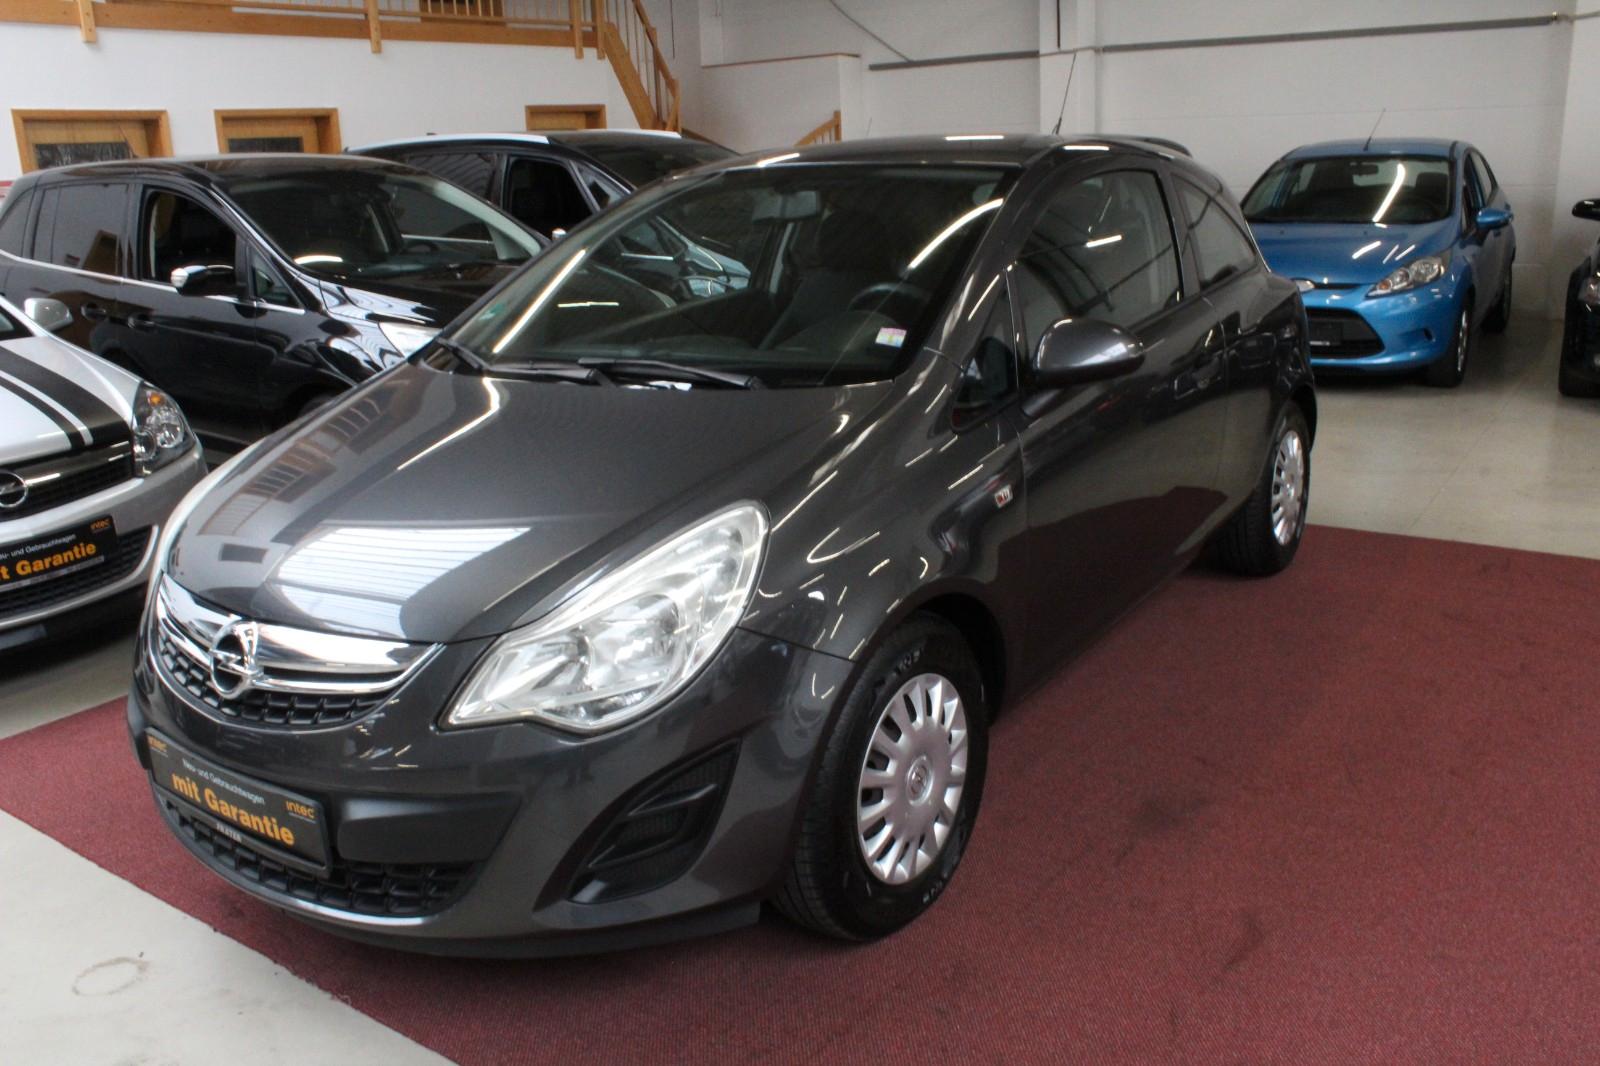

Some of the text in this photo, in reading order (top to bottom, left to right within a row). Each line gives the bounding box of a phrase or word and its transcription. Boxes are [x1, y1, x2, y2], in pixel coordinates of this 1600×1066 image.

[0, 542, 97, 581] t Garantie
[11, 548, 24, 557] und
[209, 773, 265, 805] Gebrauchtwagen
[171, 772, 201, 803] mit
[204, 787, 296, 847] Garantie
[286, 801, 315, 819] intec
